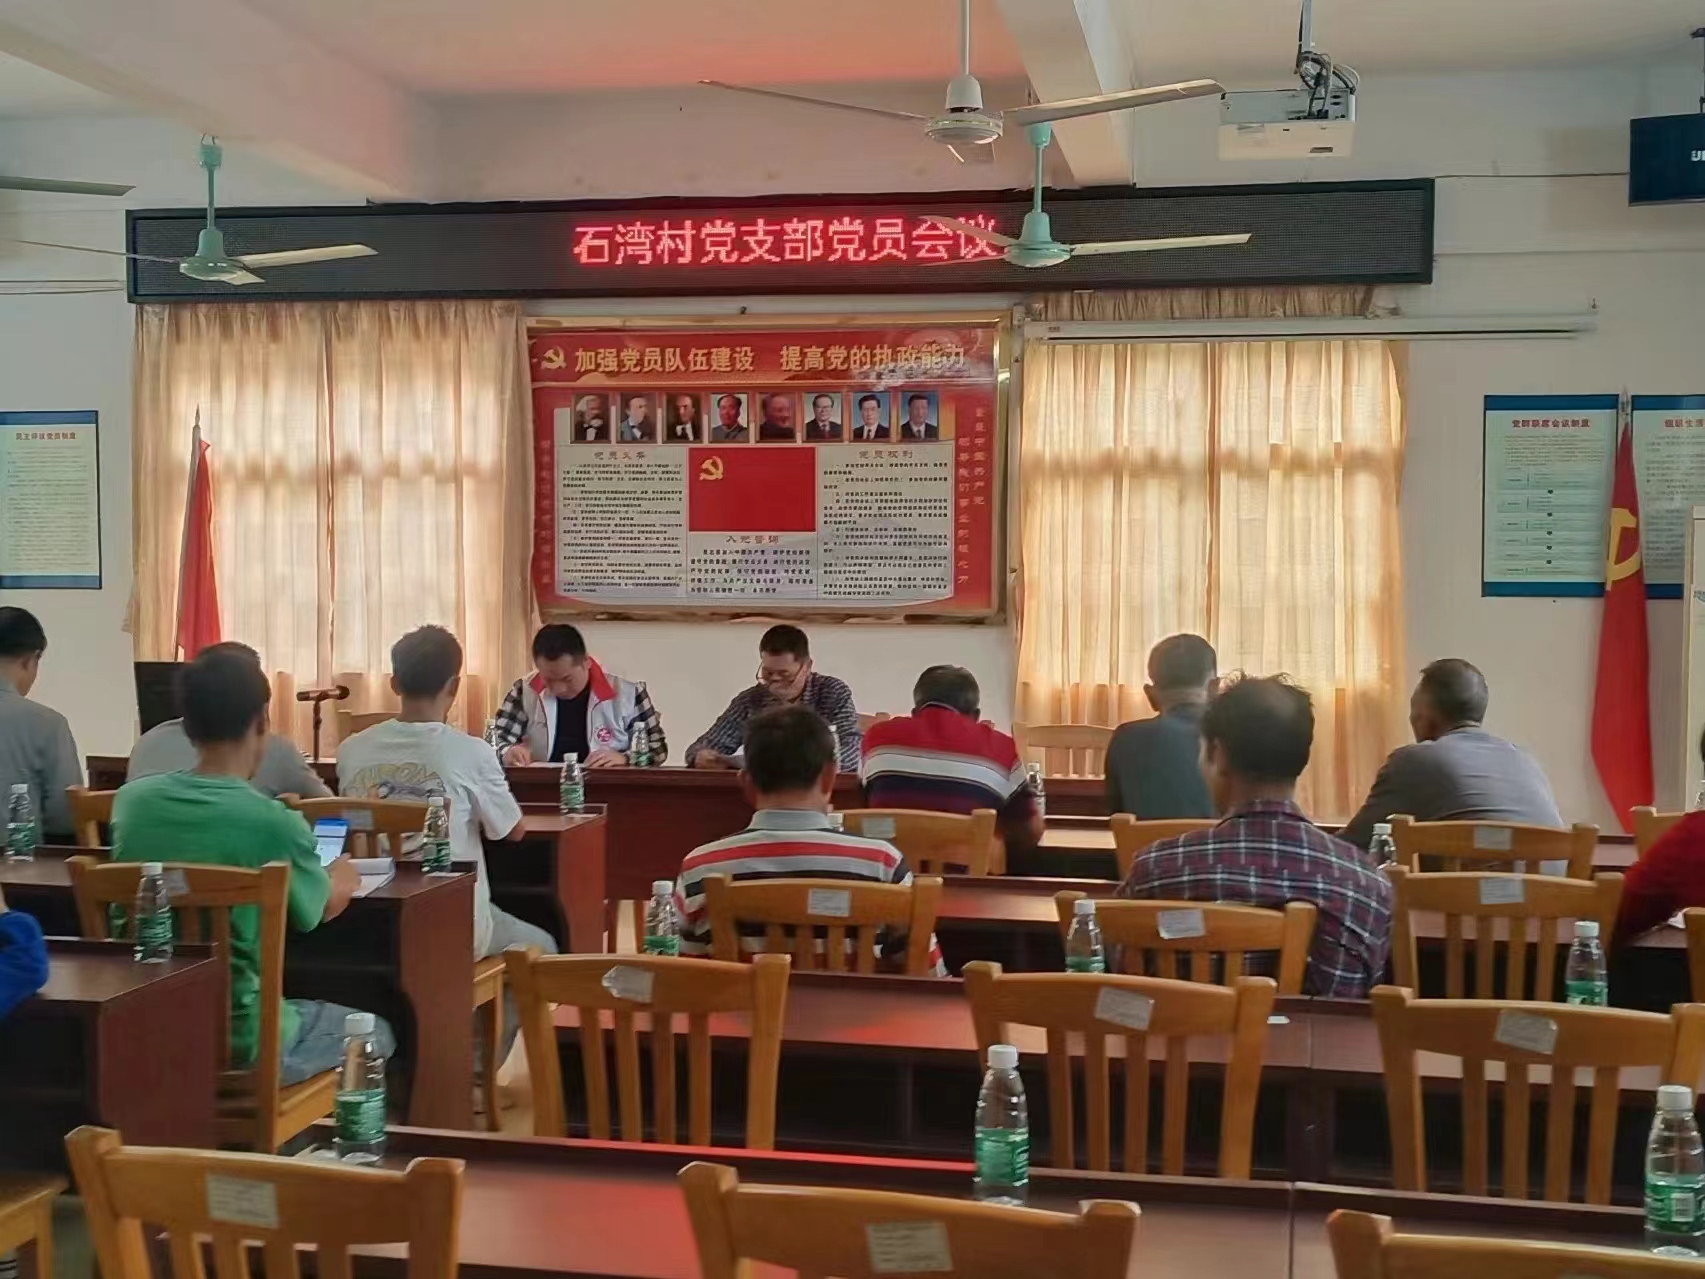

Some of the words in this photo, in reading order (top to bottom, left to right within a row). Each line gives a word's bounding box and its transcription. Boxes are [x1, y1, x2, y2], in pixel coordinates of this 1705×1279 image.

[573, 213, 998, 264] 石湾村党支部党员会议
[574, 346, 756, 373] 加强党员队伍建设
[779, 342, 965, 372] 提高党的执政能力
